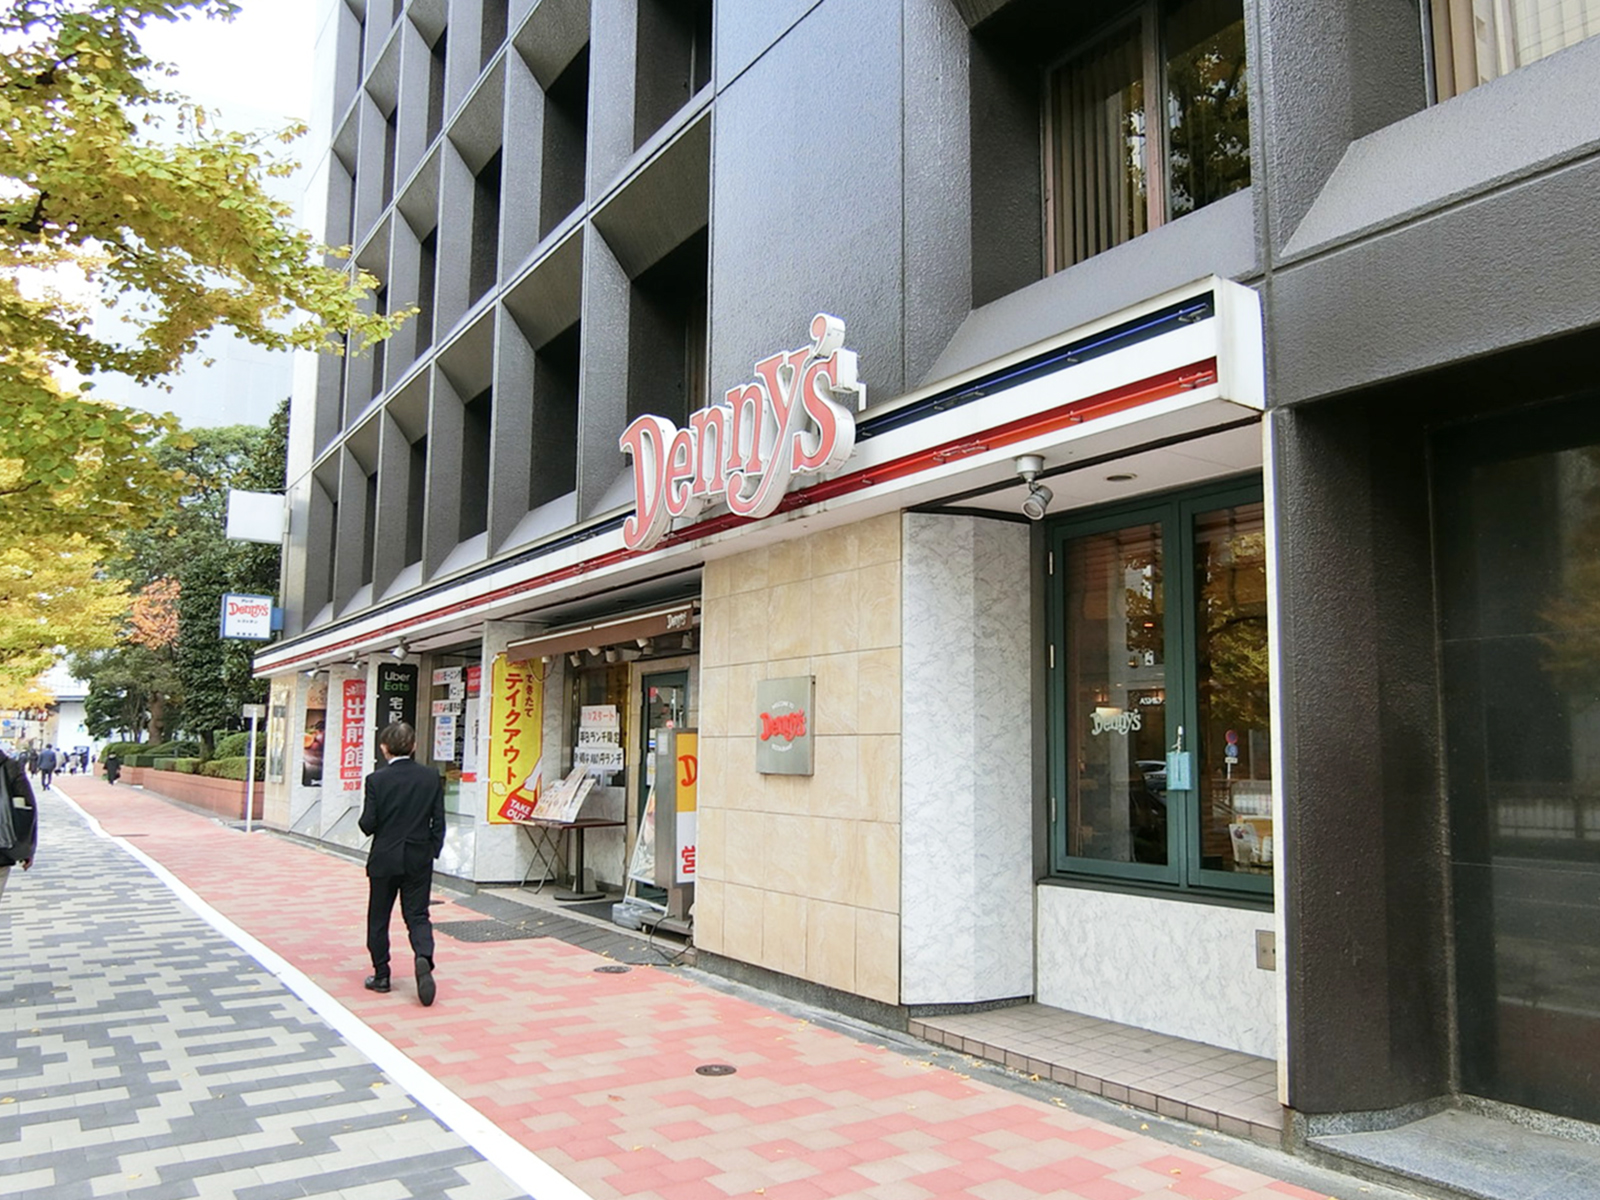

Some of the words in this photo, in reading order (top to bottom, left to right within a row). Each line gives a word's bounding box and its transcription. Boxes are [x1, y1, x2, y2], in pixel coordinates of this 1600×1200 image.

[619, 312, 848, 551] Denny's
[228, 602, 269, 618] Denny's
[384, 671, 411, 681] Uber
[384, 681, 411, 691] Eats
[524, 673, 534, 718] できたて
[503, 672, 524, 785] テイクアウト
[759, 707, 807, 742] Denny's
[1089, 708, 1142, 735] Denny's
[506, 808, 527, 821] OUT
[510, 798, 532, 815] TAKE
